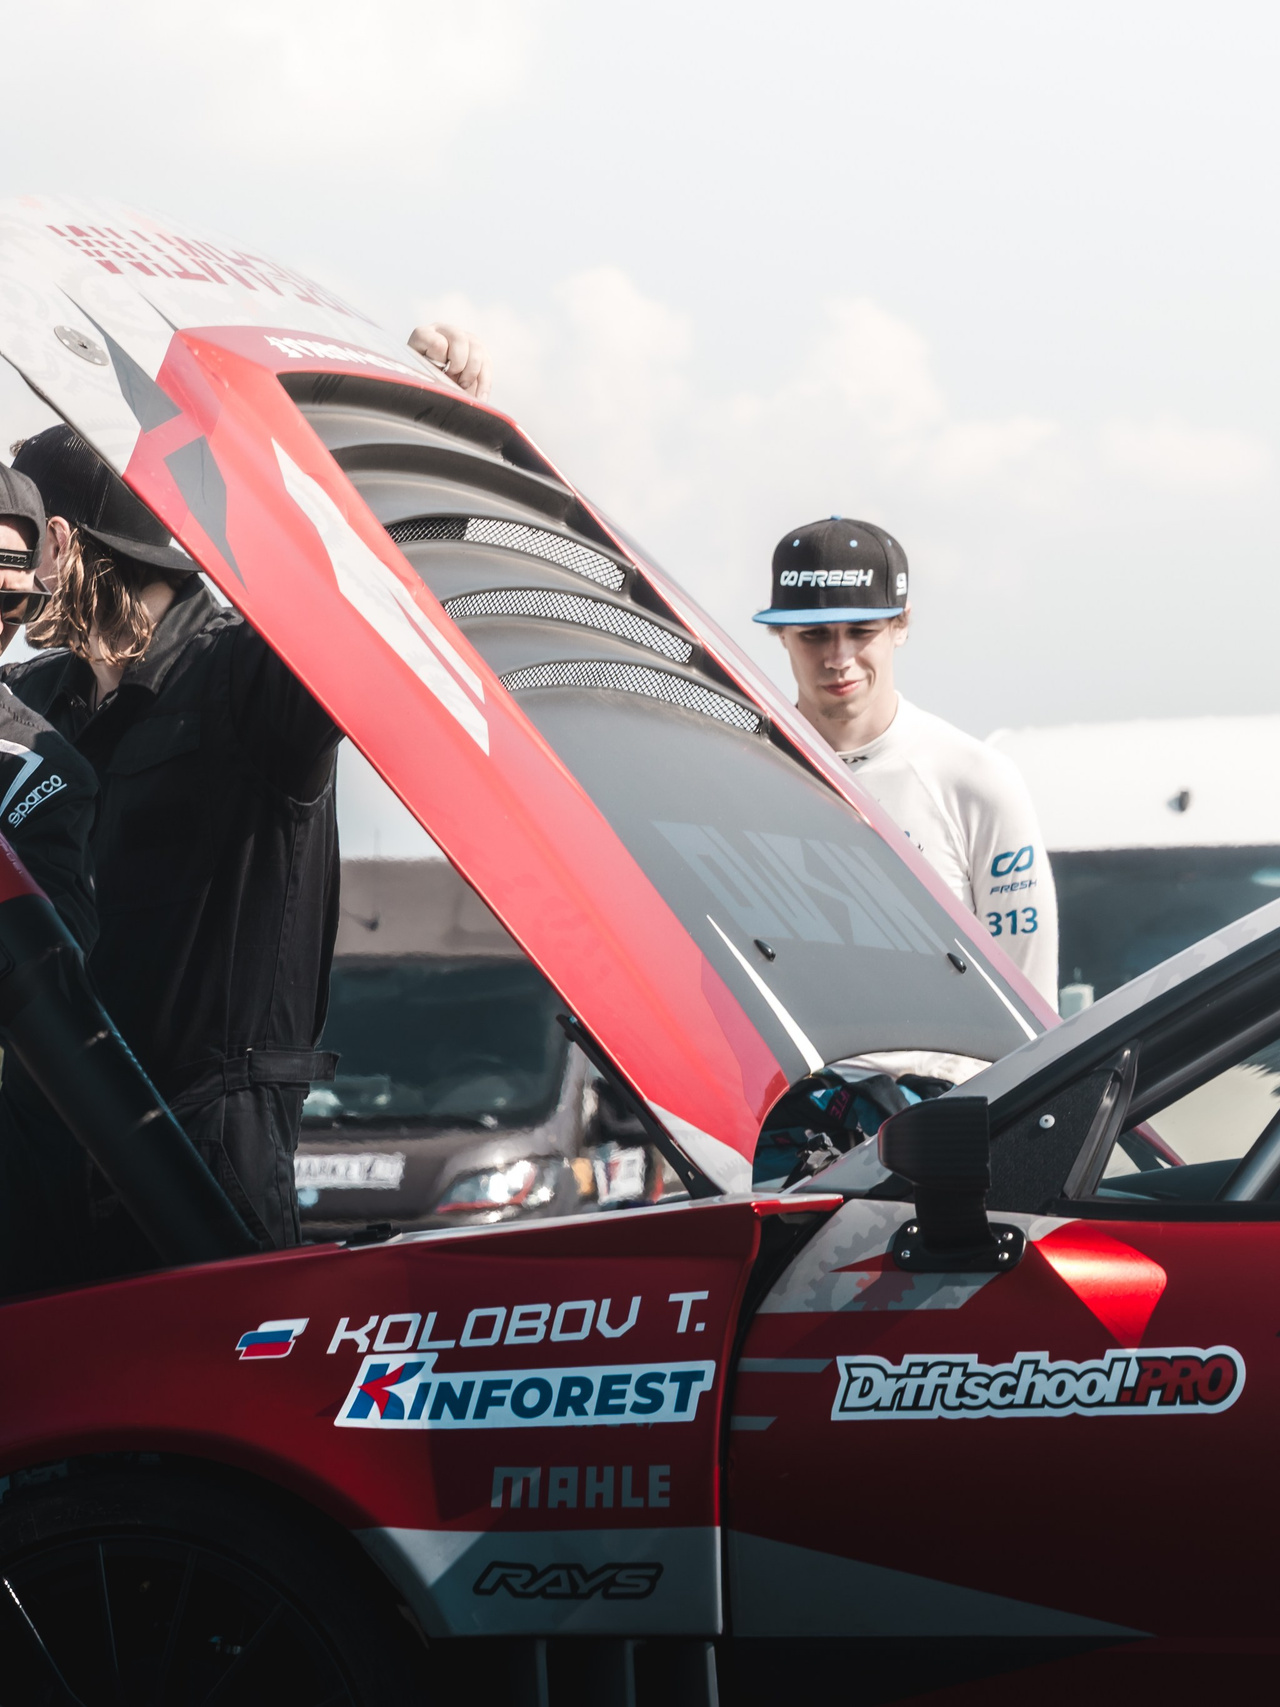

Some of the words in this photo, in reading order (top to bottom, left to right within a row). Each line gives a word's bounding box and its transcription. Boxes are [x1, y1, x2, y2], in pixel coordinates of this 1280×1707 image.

[798, 569, 874, 588] FRESH
[7, 773, 67, 828] sparco
[990, 878, 1038, 895] FRESH
[987, 907, 1038, 936] 313
[326, 1295, 642, 1355] KOLOBOV
[668, 1290, 710, 1334] T.
[346, 1360, 706, 1420] KINFOREST
[838, 1353, 1239, 1413] Driftschool.PRO
[490, 1464, 672, 1509] MAHLE
[472, 1561, 664, 1600] RAYS
